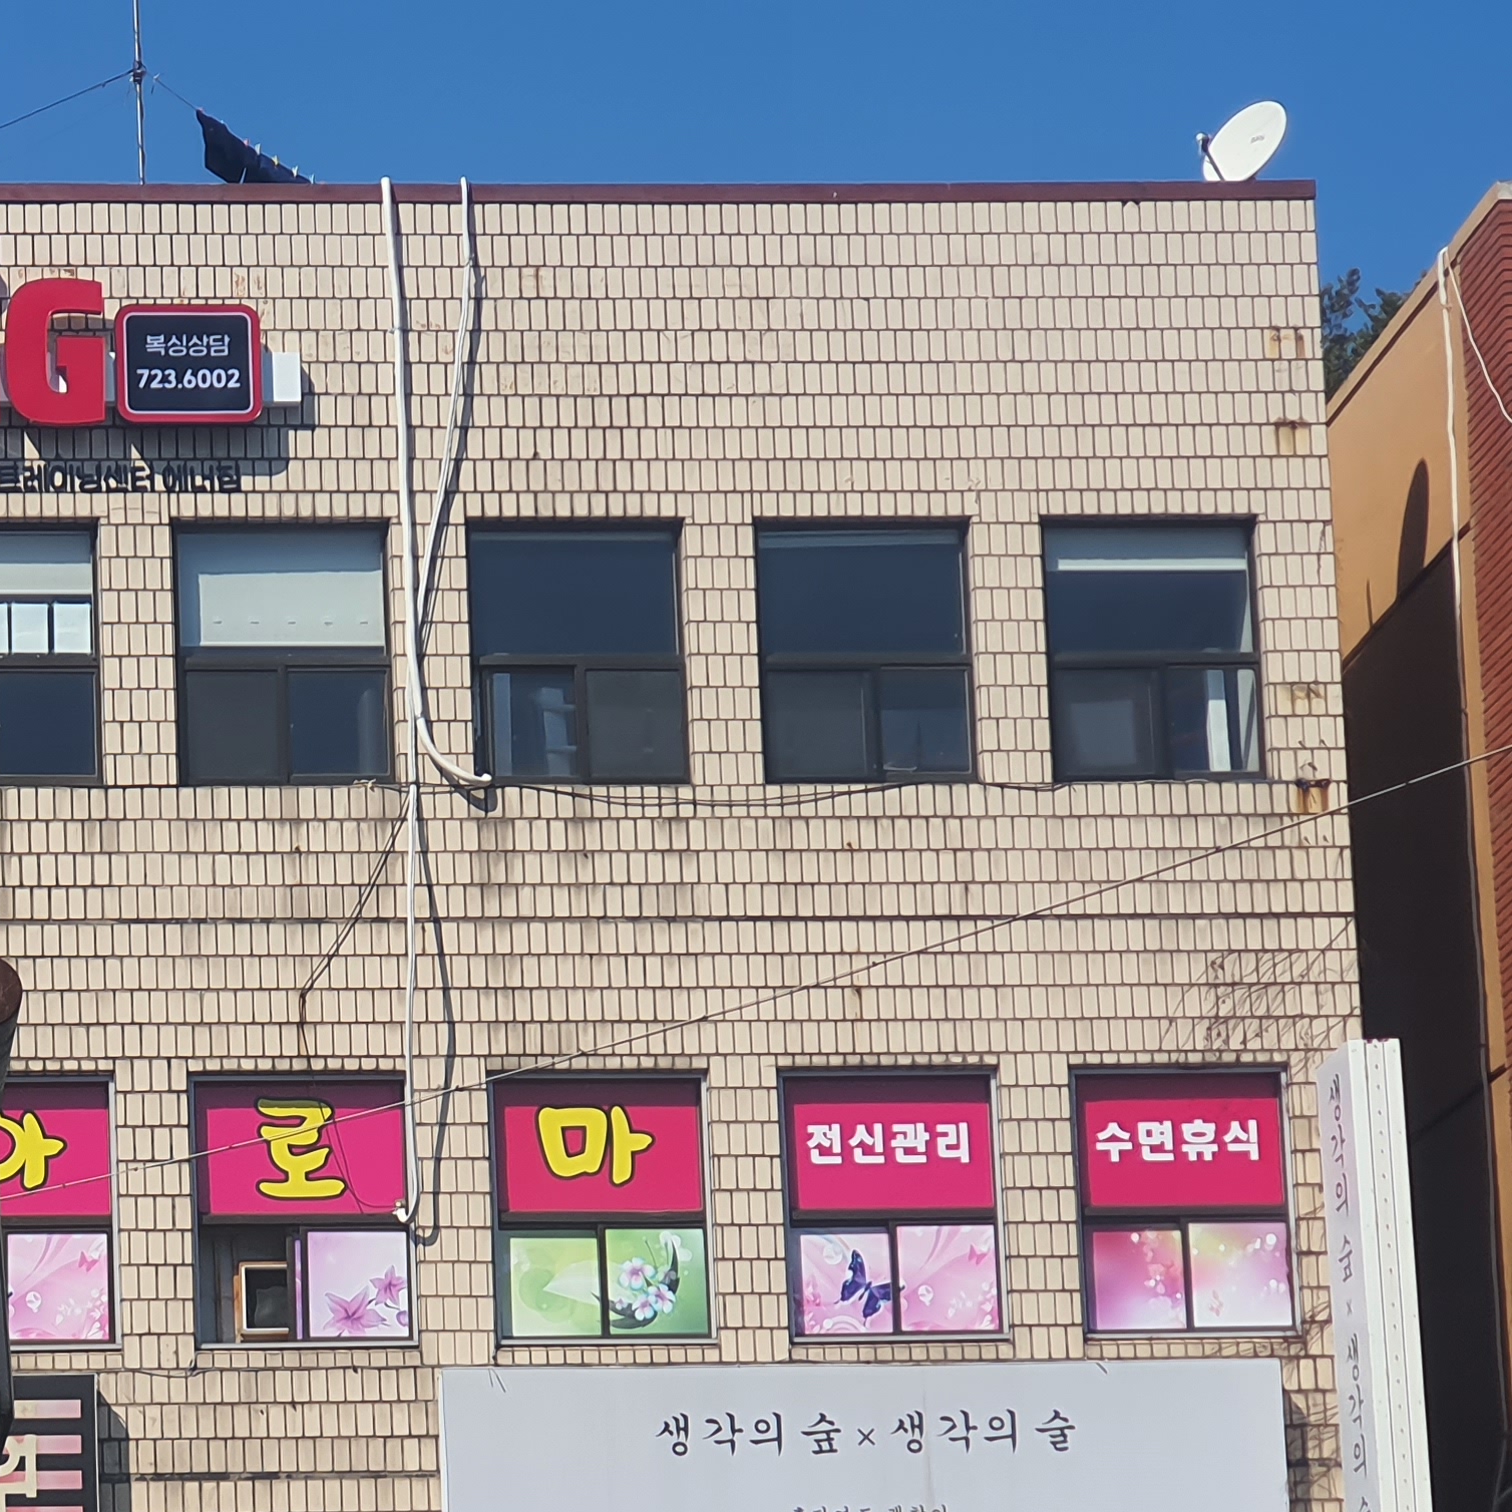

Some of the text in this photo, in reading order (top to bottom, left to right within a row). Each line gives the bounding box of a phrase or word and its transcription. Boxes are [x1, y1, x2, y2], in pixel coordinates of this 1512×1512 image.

[144, 331, 231, 359] 복싱상담
[136, 367, 241, 391] 723.6002
[805, 1120, 970, 1166] 전신관리
[1095, 1117, 1260, 1162] 수면휴식
[1328, 1073, 1350, 1218] 생각의
[1346, 1332, 1368, 1479] 생각의
[655, 1411, 784, 1457] 생각의
[799, 1411, 843, 1456] 숲
[890, 1408, 1018, 1455] 생각의
[1034, 1409, 1077, 1453] 술
